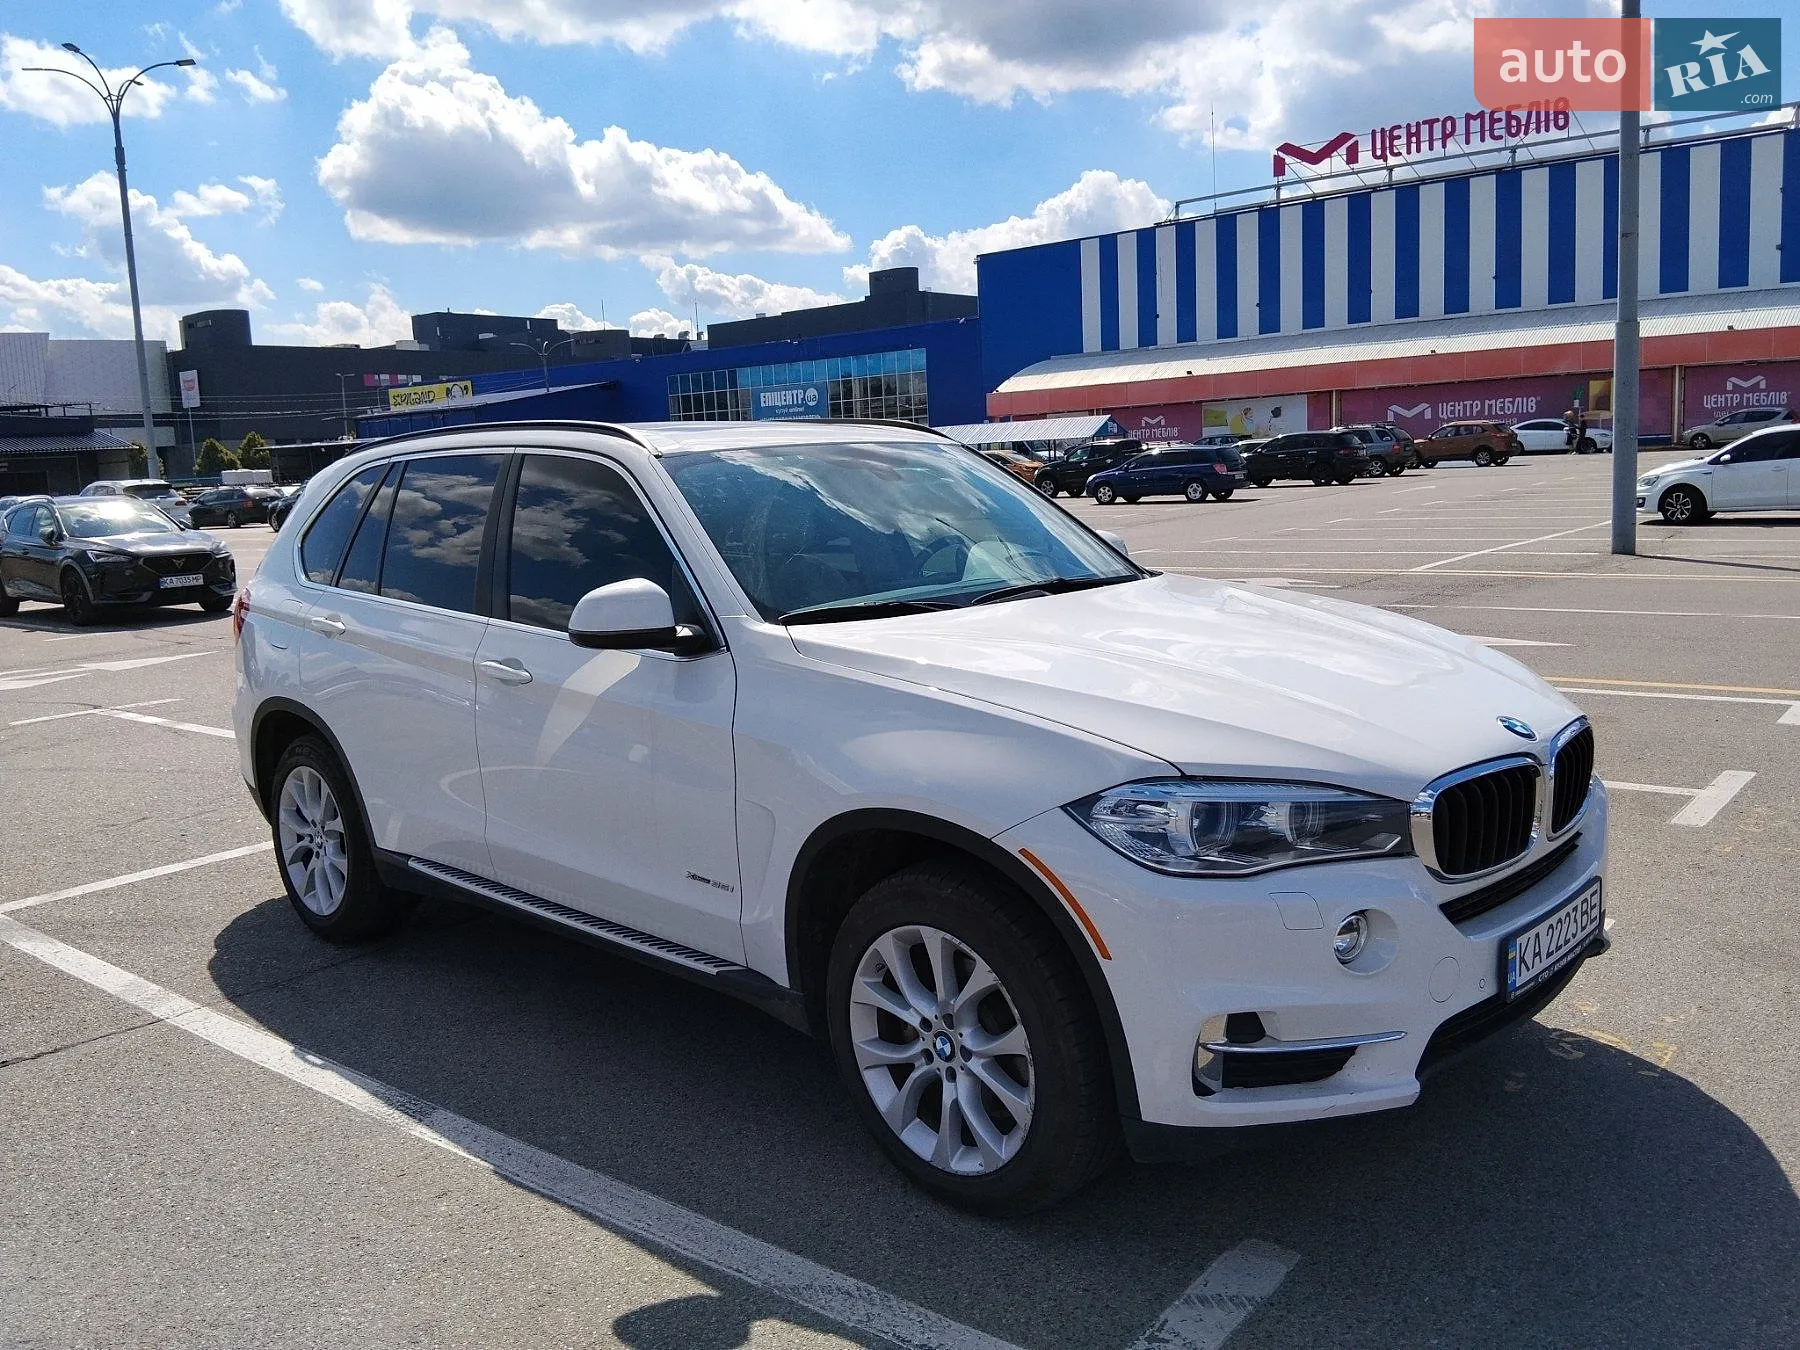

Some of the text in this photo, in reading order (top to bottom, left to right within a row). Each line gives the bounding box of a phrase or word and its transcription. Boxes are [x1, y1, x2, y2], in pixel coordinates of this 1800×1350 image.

[1370, 96, 1570, 163] ЦЕНТР МЕБЛІВ
[1438, 396, 1537, 420] ЦЕНТР МЕБЛІВ
[1703, 391, 1788, 409] ЦЕНТР МЕБЛІВ
[1518, 932, 1542, 978] KA
[1546, 904, 1578, 959] 2223
[1581, 889, 1598, 932] BE
[1507, 971, 1516, 984] UA
